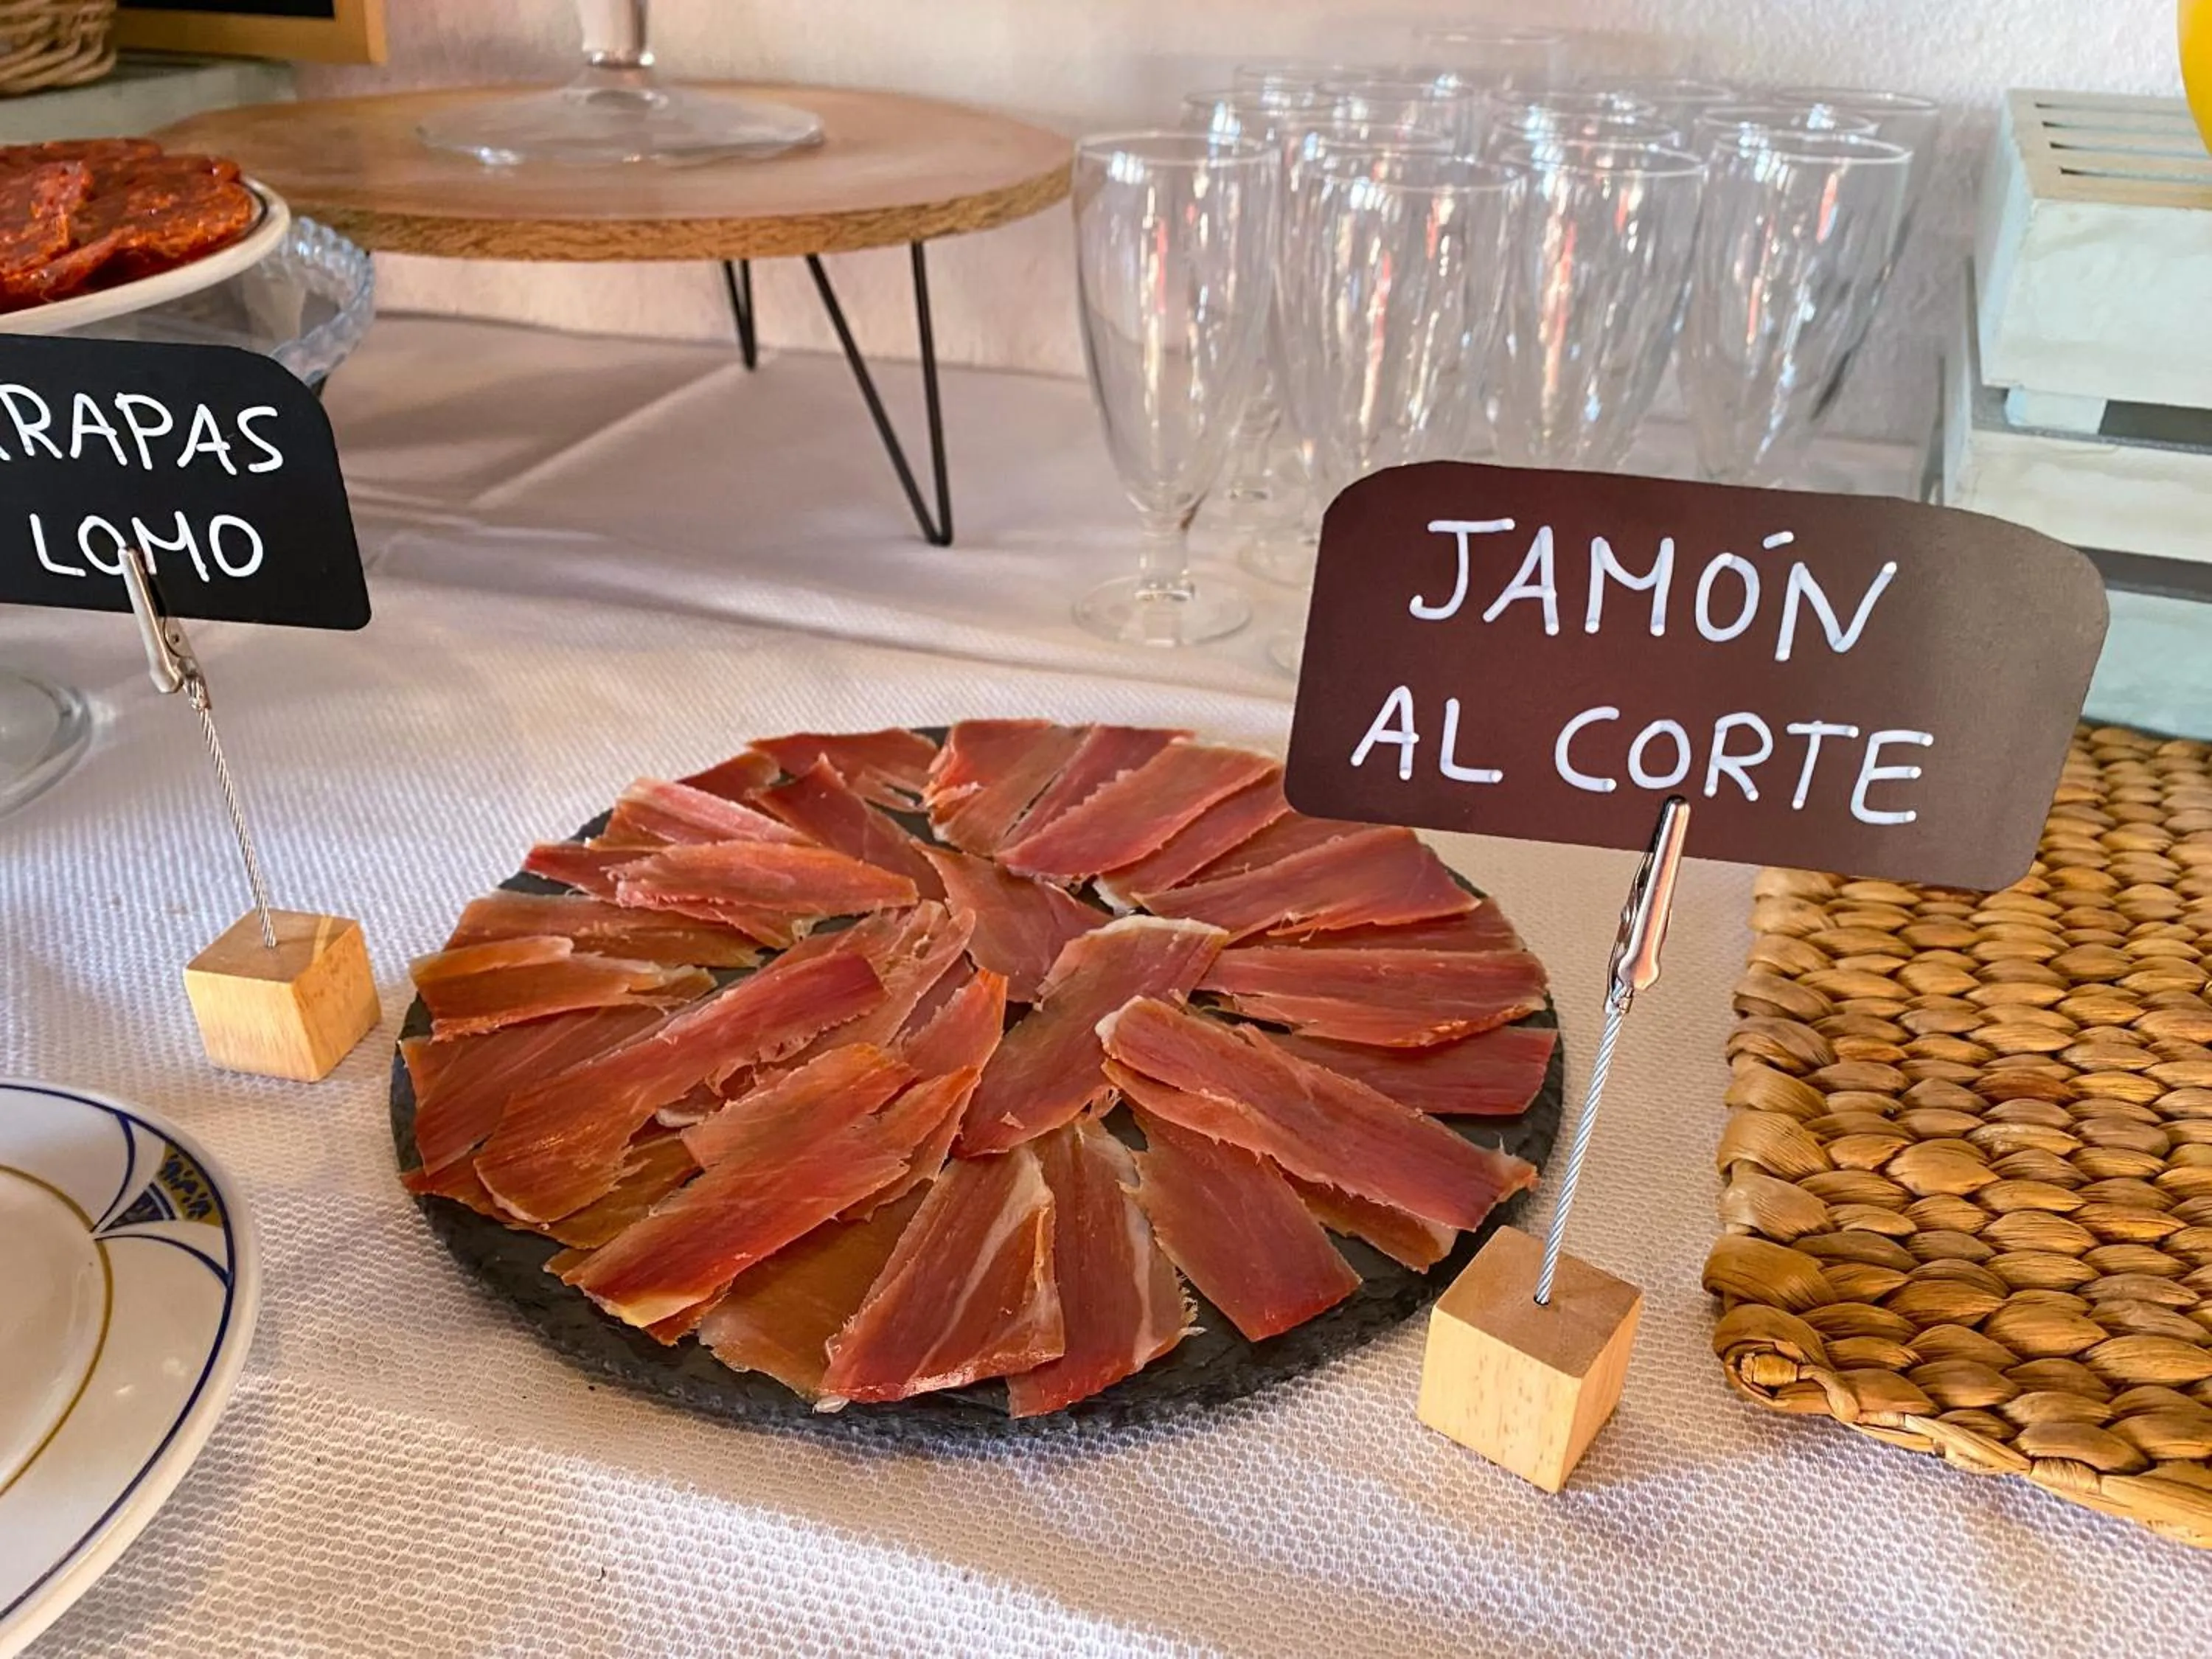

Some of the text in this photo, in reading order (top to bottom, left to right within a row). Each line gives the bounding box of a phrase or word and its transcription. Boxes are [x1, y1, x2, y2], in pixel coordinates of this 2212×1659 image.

[0, 383, 285, 476] RAPAS
[29, 510, 264, 583] LOMO
[1408, 517, 1898, 662] JAMÓN
[1350, 684, 1935, 825] AL CORTE
